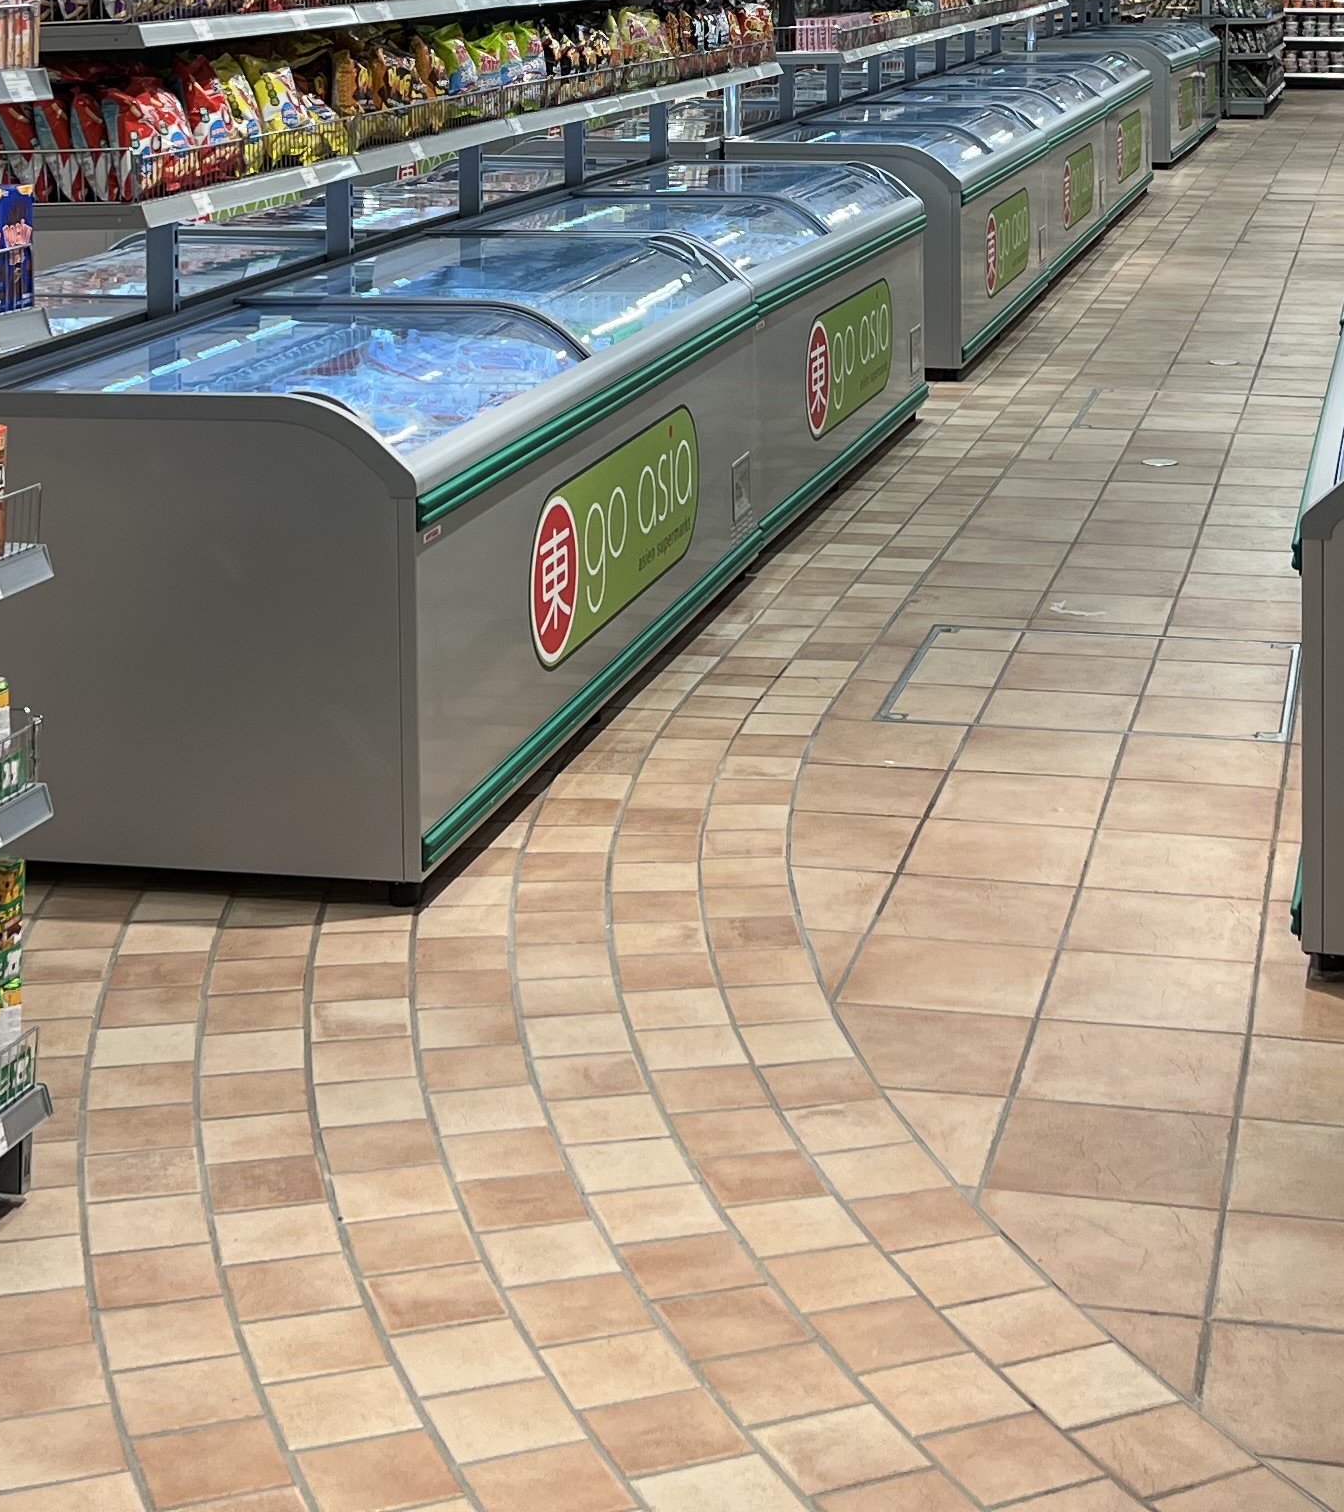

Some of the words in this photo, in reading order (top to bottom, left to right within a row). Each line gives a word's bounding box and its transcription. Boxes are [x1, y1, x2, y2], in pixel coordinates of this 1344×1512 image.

[811, 342, 826, 414] 東
[832, 325, 855, 410] go
[859, 291, 889, 365] asia
[584, 486, 628, 614] go
[637, 425, 692, 535] asia
[539, 528, 571, 636] 東
